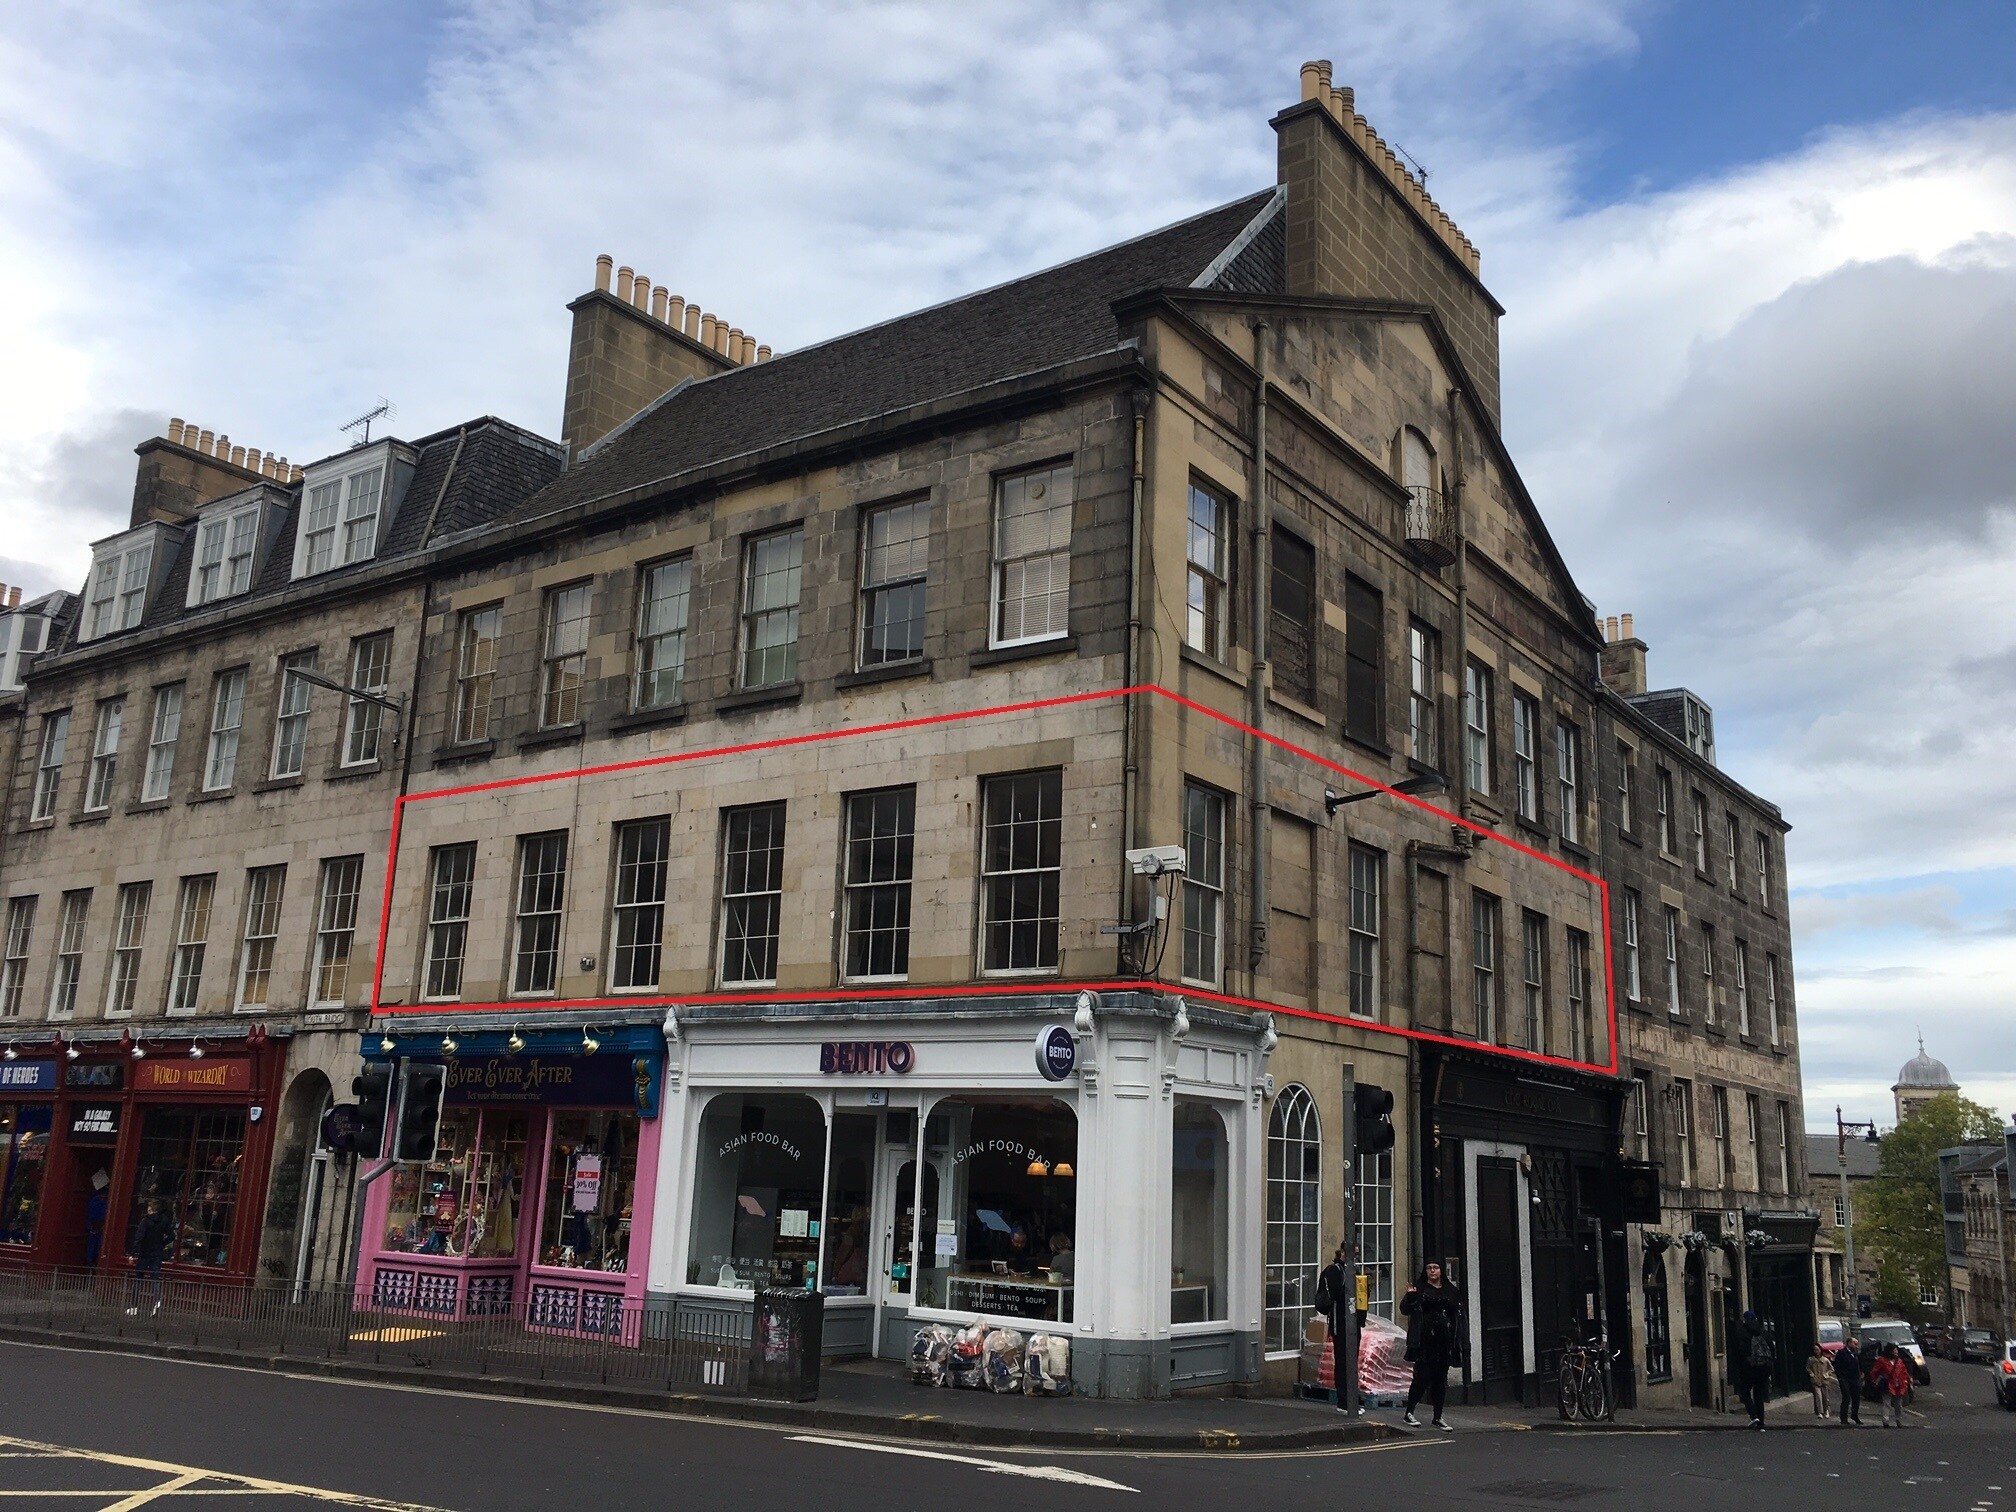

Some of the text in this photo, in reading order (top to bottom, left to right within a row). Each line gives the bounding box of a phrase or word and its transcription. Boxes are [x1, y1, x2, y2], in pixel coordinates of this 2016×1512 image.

[820, 1041, 915, 1074] BENTO
[1049, 1045, 1072, 1060] BENTO
[2, 1066, 39, 1084] OF HEROES
[153, 1064, 181, 1085] WORLD
[187, 1064, 229, 1085] WIZARDRY
[446, 1059, 572, 1089] EVER EVER AFTER
[719, 1131, 801, 1161] ASIAN FOOD BAR
[950, 1142, 985, 1167] ASIAN
[989, 1139, 1024, 1154] FOOD
[906, 1207, 927, 1216] BEO
[754, 1271, 771, 1279] BENTO
[775, 1273, 792, 1281] SOUPS
[971, 1300, 1019, 1312] DESSERTS TEA
[982, 1292, 995, 1300] SUM
[999, 1294, 1020, 1303] BENTO
[1025, 1296, 1047, 1305] SOUPS
